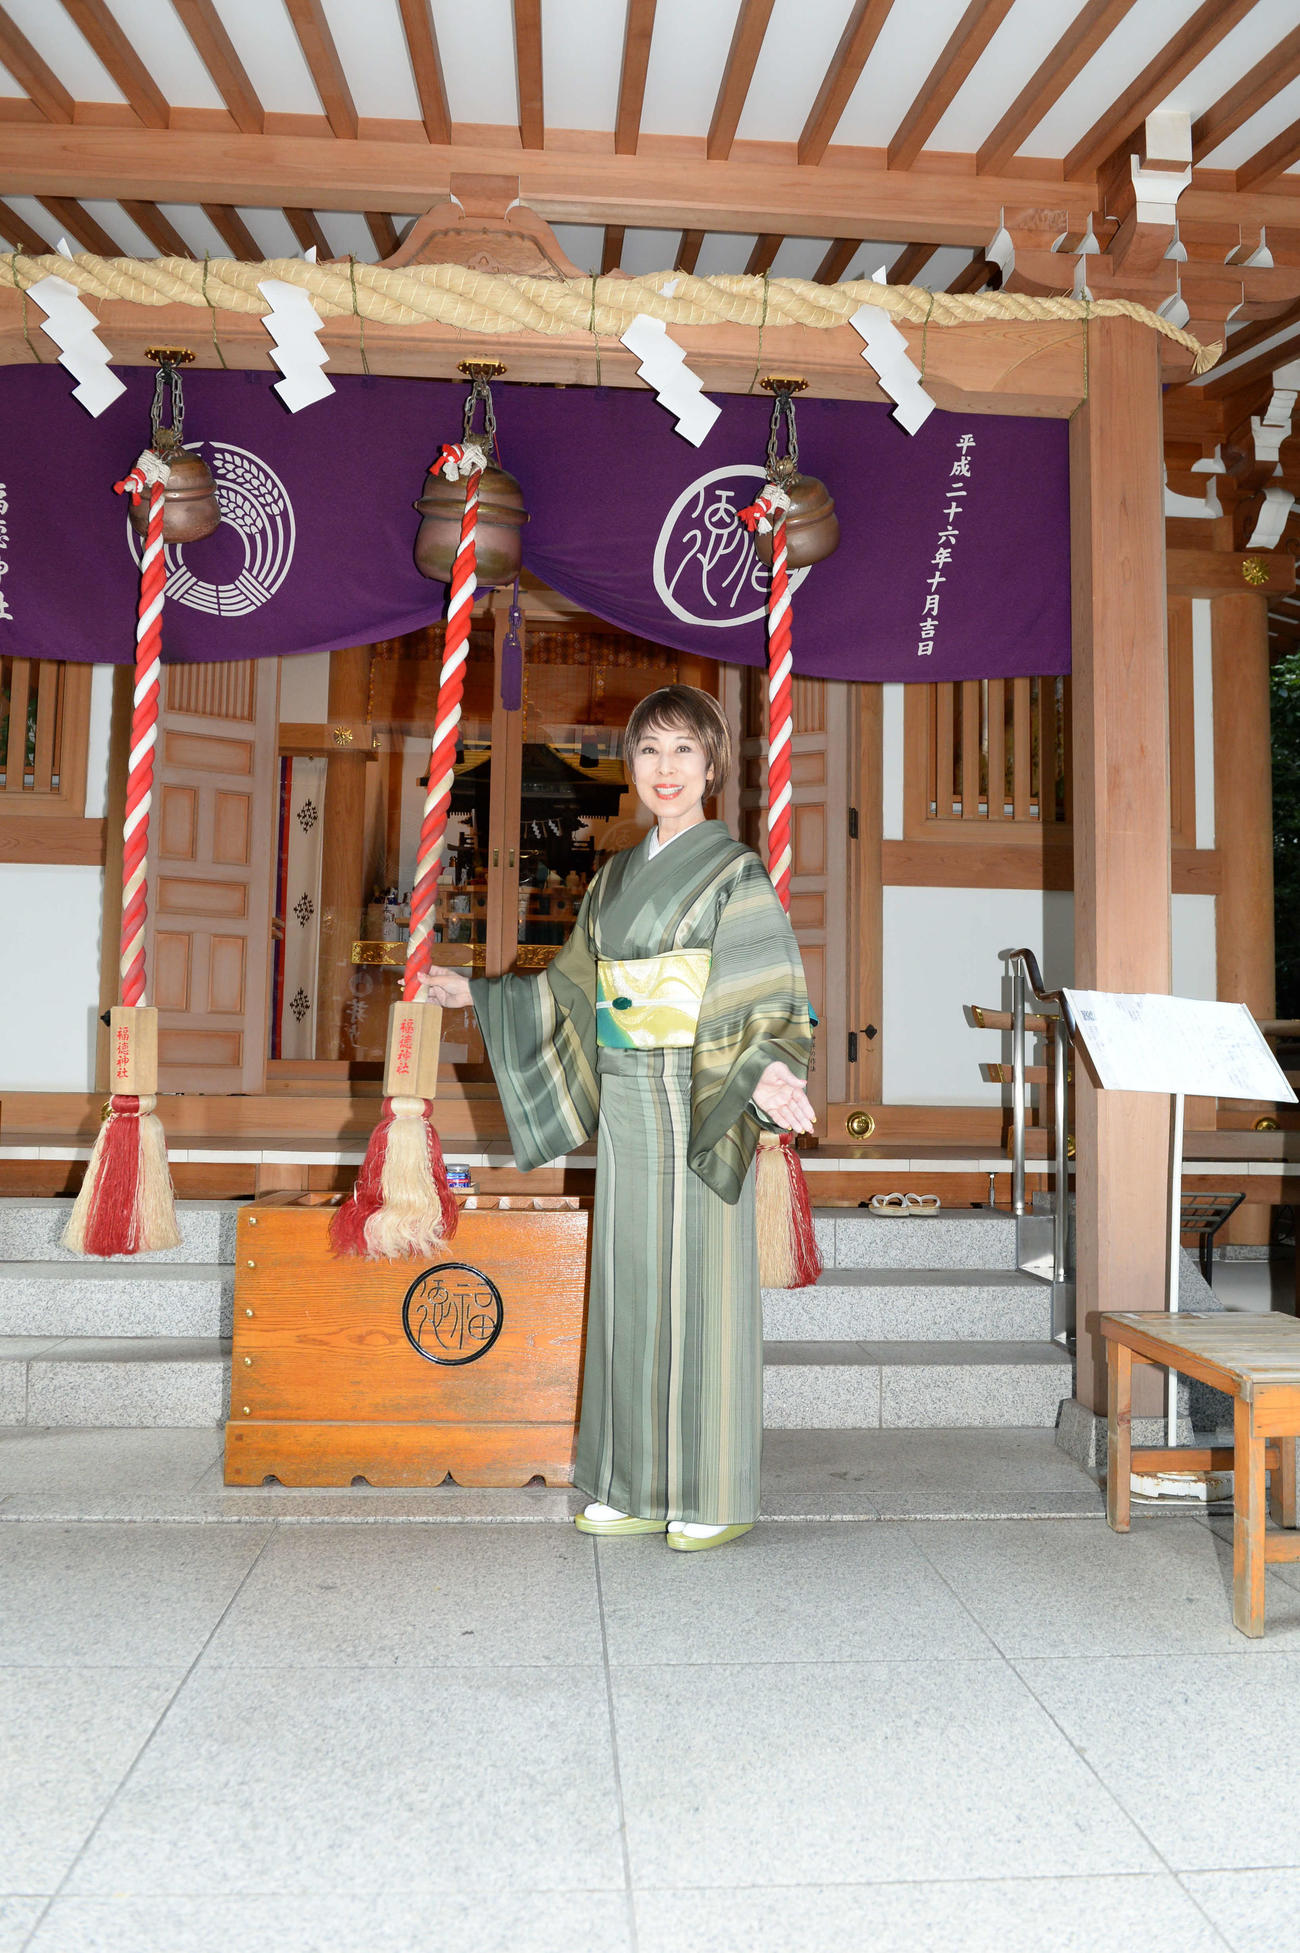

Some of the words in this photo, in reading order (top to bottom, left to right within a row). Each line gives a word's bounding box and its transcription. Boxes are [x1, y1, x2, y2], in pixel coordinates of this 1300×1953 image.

[917, 433, 977, 656] 平成二十六年十月吉日
[116, 1026, 130, 1078] 福徳神社
